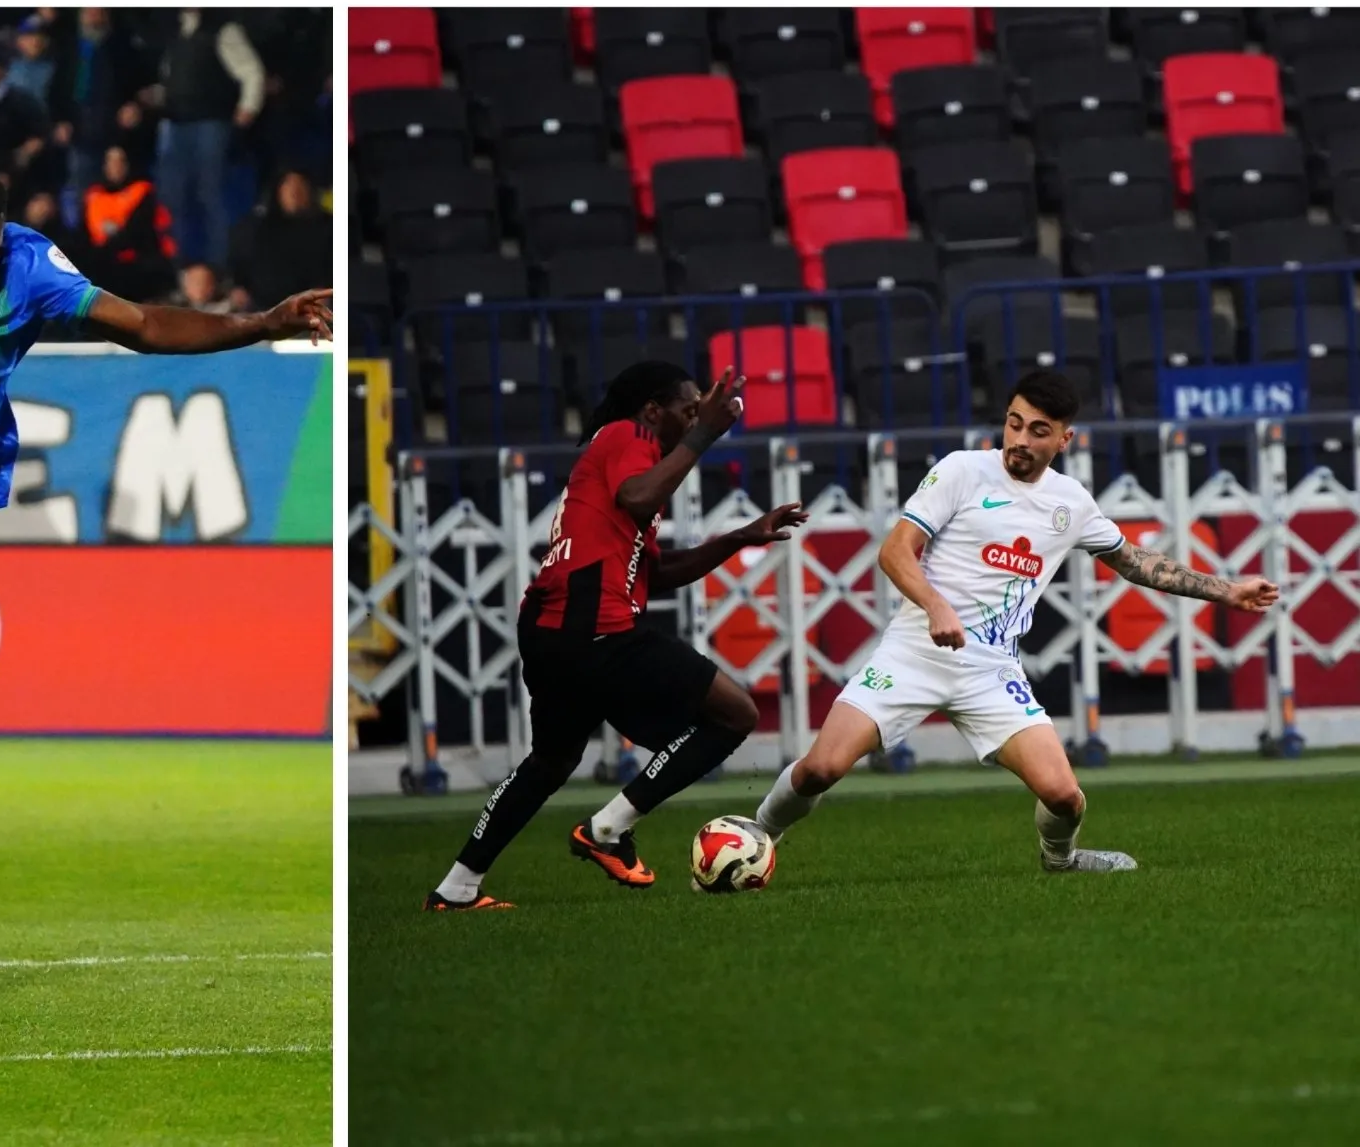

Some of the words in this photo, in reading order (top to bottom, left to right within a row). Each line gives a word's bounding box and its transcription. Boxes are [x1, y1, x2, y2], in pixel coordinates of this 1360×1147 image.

[986, 548, 1040, 576] ÇAYKUR
[645, 749, 670, 780] GBB
[472, 809, 491, 840] GBB
